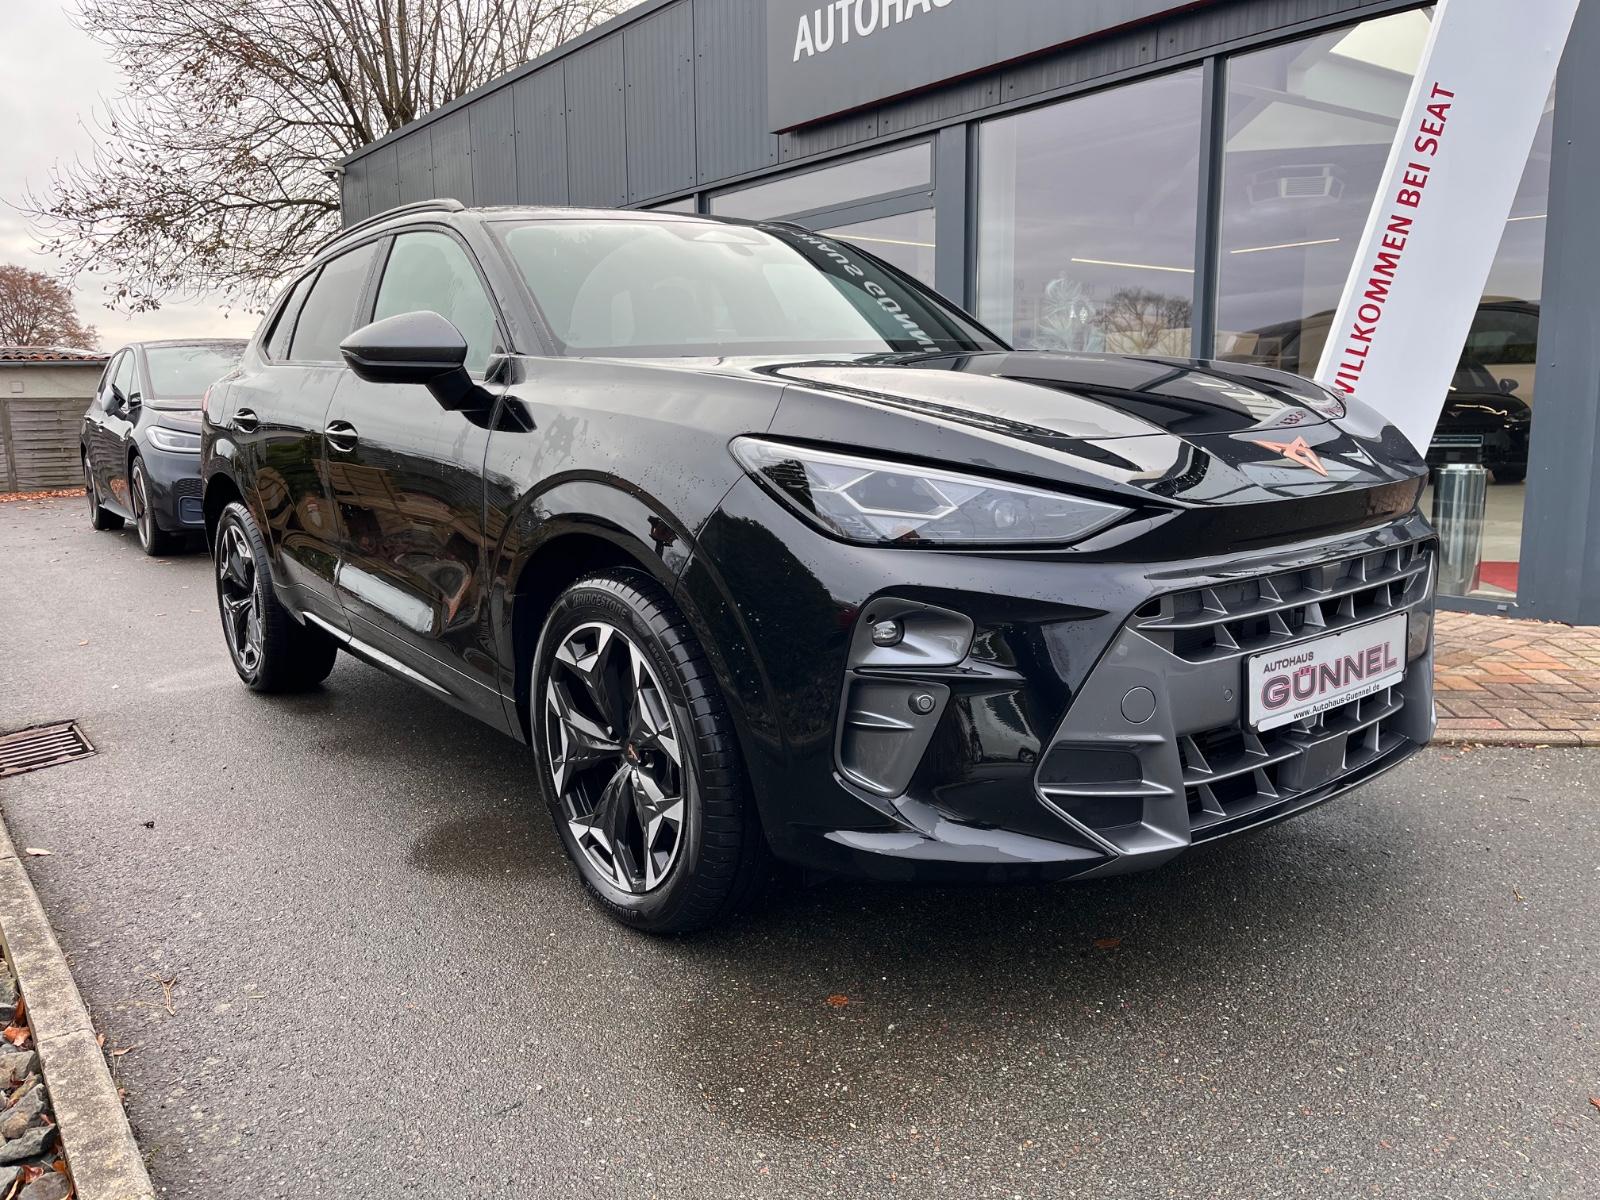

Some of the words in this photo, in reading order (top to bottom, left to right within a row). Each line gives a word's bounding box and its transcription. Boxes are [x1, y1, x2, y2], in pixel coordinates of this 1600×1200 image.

[793, 0, 952, 63] AUTOH
[1396, 162, 1431, 208] BEI
[1414, 82, 1455, 156] SEAT
[1261, 641, 1398, 711] GÜNNEL
[1263, 651, 1314, 674] AUTOHAUS
[1293, 683, 1380, 720] www.Autohaus-Guennel.de
